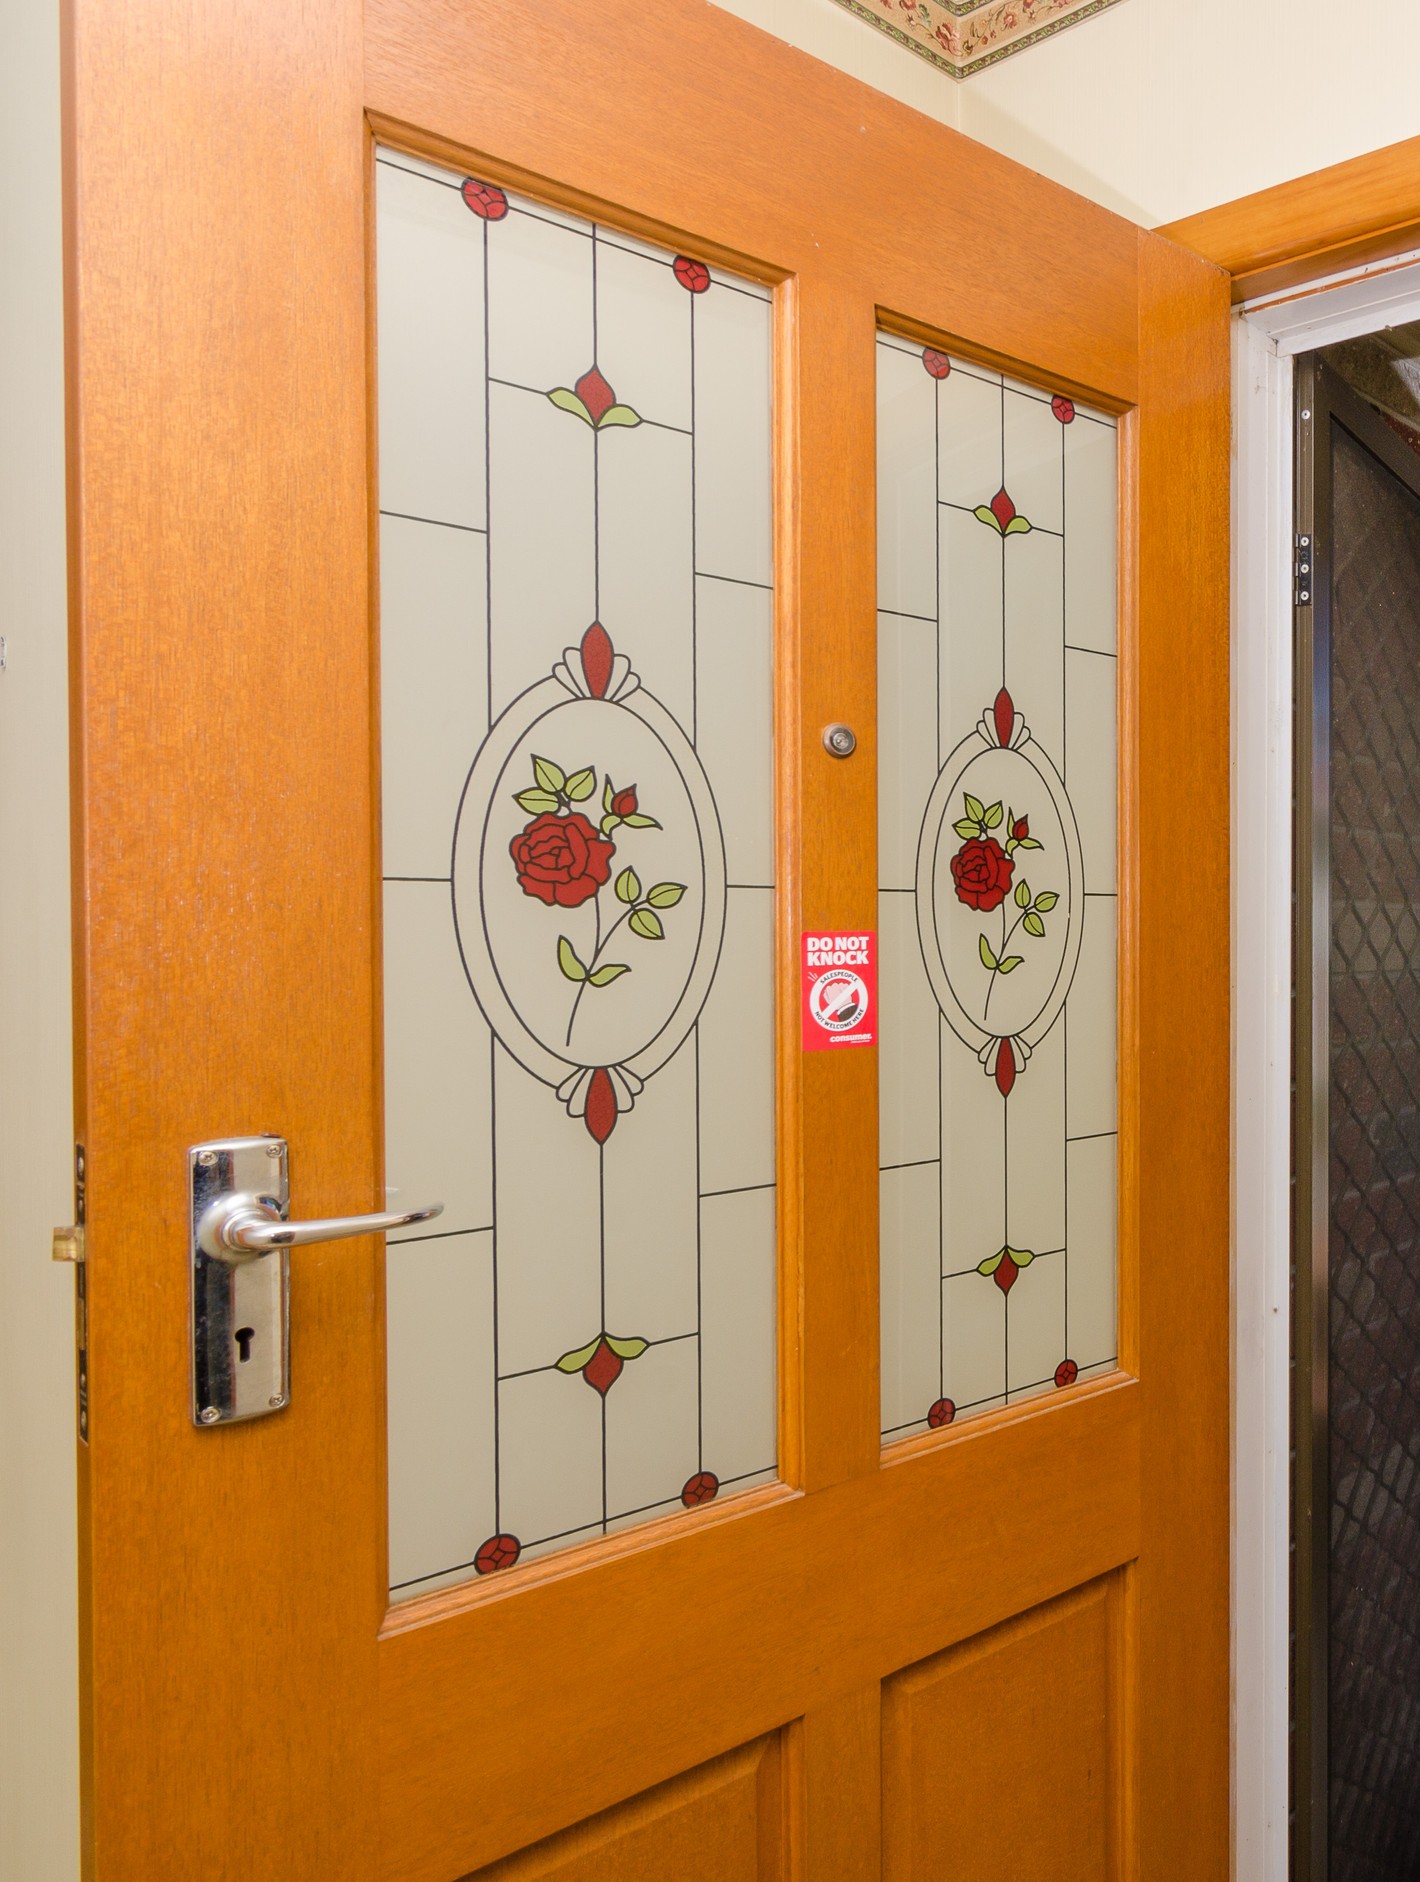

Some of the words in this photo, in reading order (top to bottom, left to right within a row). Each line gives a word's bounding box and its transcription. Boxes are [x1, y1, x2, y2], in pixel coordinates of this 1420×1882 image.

[807, 937, 833, 951] DO
[835, 936, 869, 951] NOT
[807, 951, 869, 966] KNOCK
[820, 971, 858, 984] SALESPEOPLE
[815, 1011, 825, 1023] NOT
[824, 1020, 853, 1030] WELCOME
[852, 1008, 864, 1024] HERE
